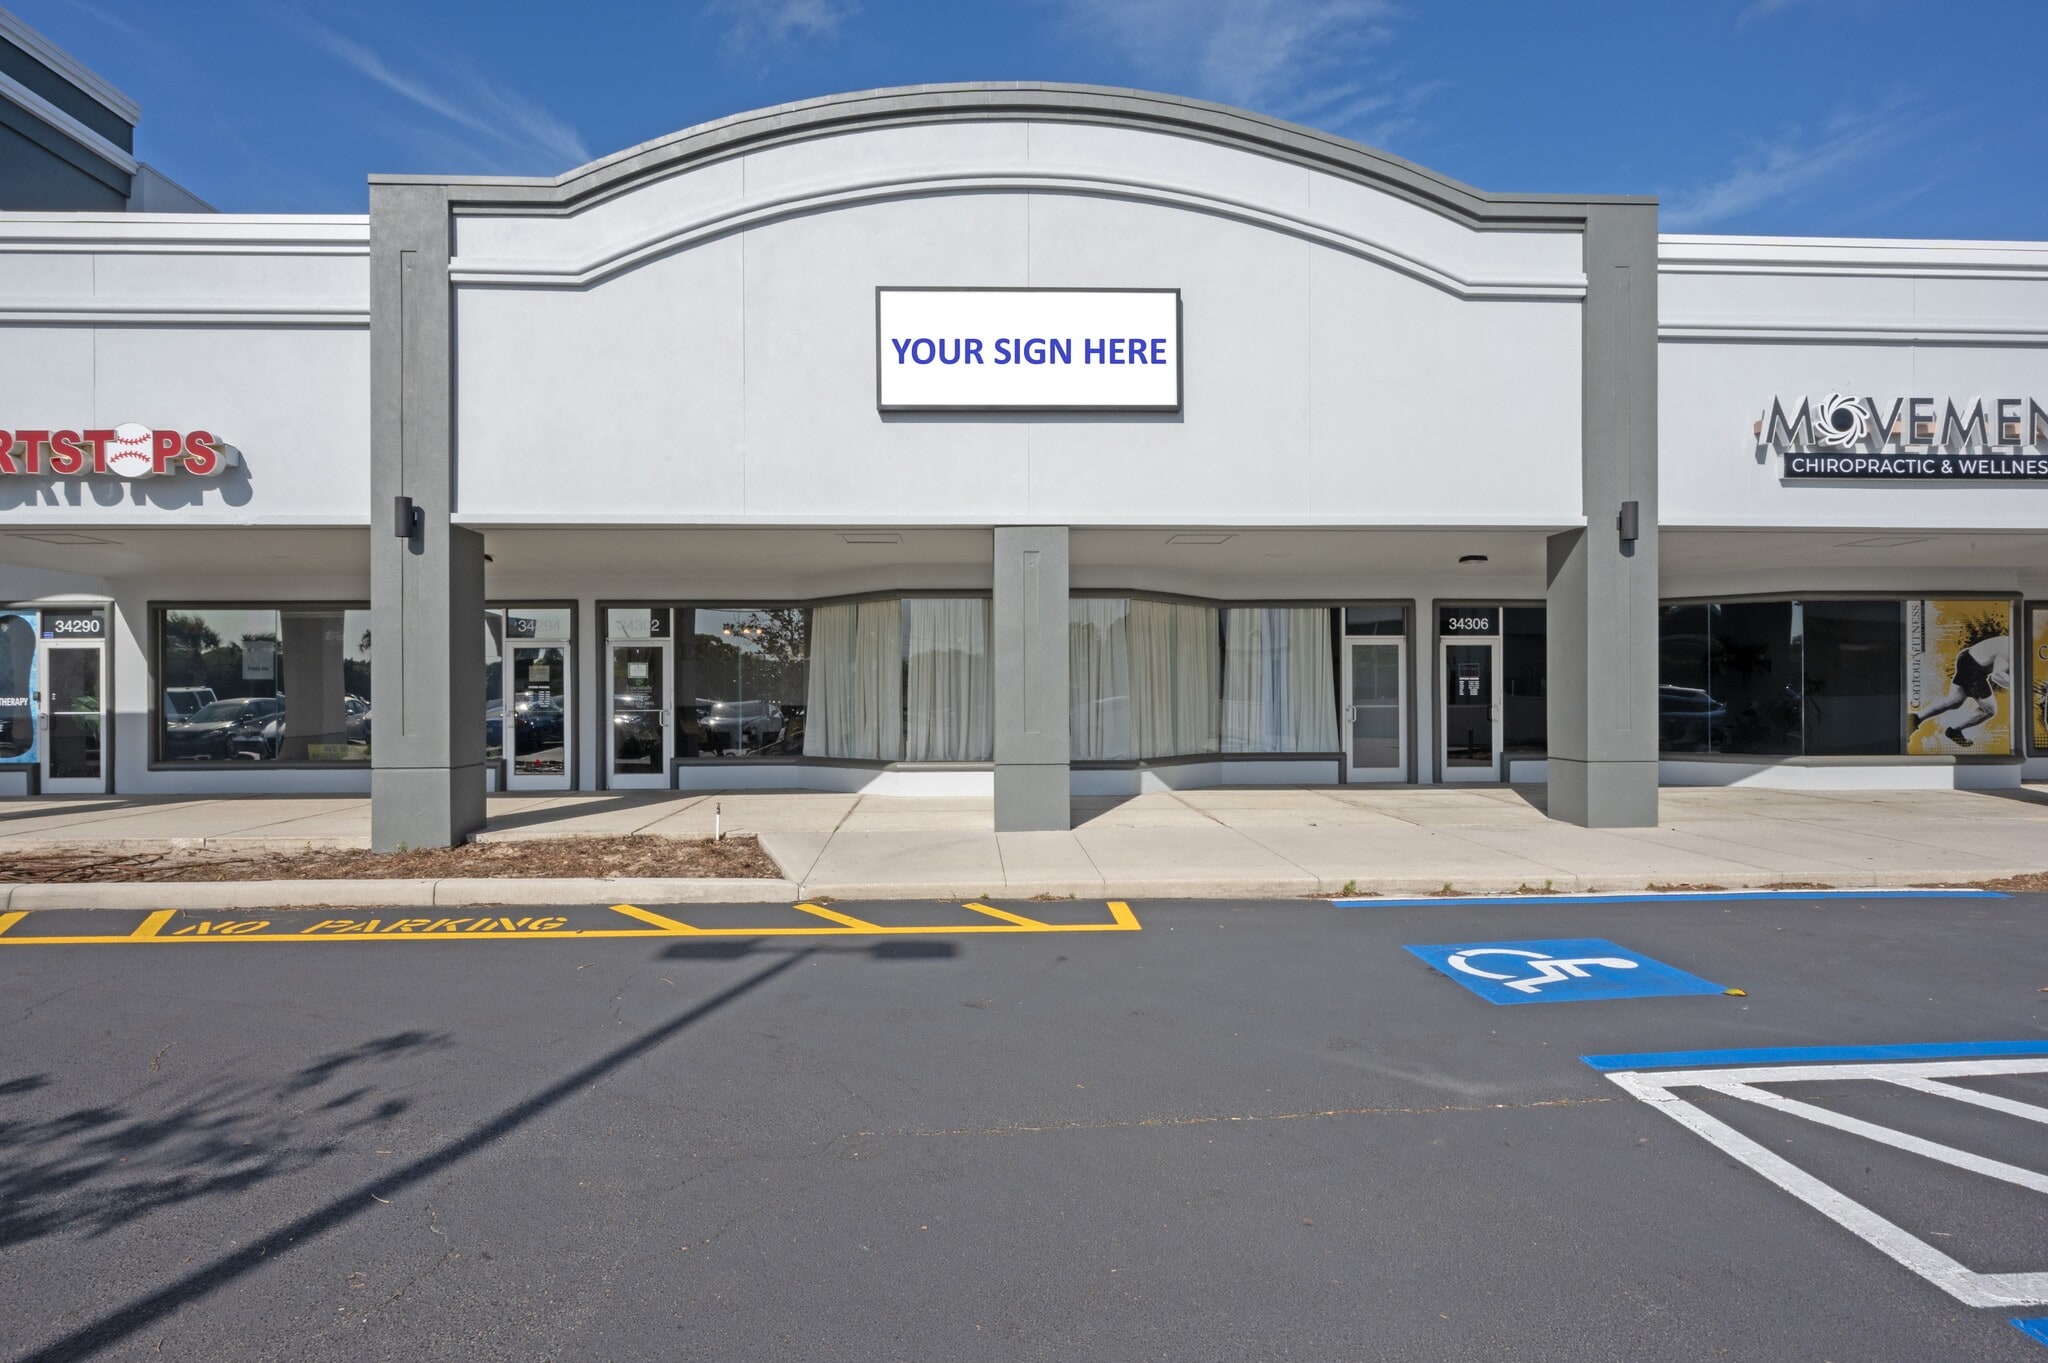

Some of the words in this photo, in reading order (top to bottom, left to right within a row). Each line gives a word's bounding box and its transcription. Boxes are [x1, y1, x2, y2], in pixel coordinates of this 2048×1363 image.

[892, 338, 984, 365] YOUR
[994, 338, 1072, 365] SIGN
[1085, 338, 1167, 365] HERE
[1792, 458, 1935, 474] CHIROPRACTIC
[1941, 459, 1953, 474] &
[1958, 459, 2048, 474] WELLNES
[55, 620, 100, 632] 34290
[1448, 618, 1489, 630] 34306
[172, 920, 270, 935] NO
[300, 917, 568, 934] PARKING
